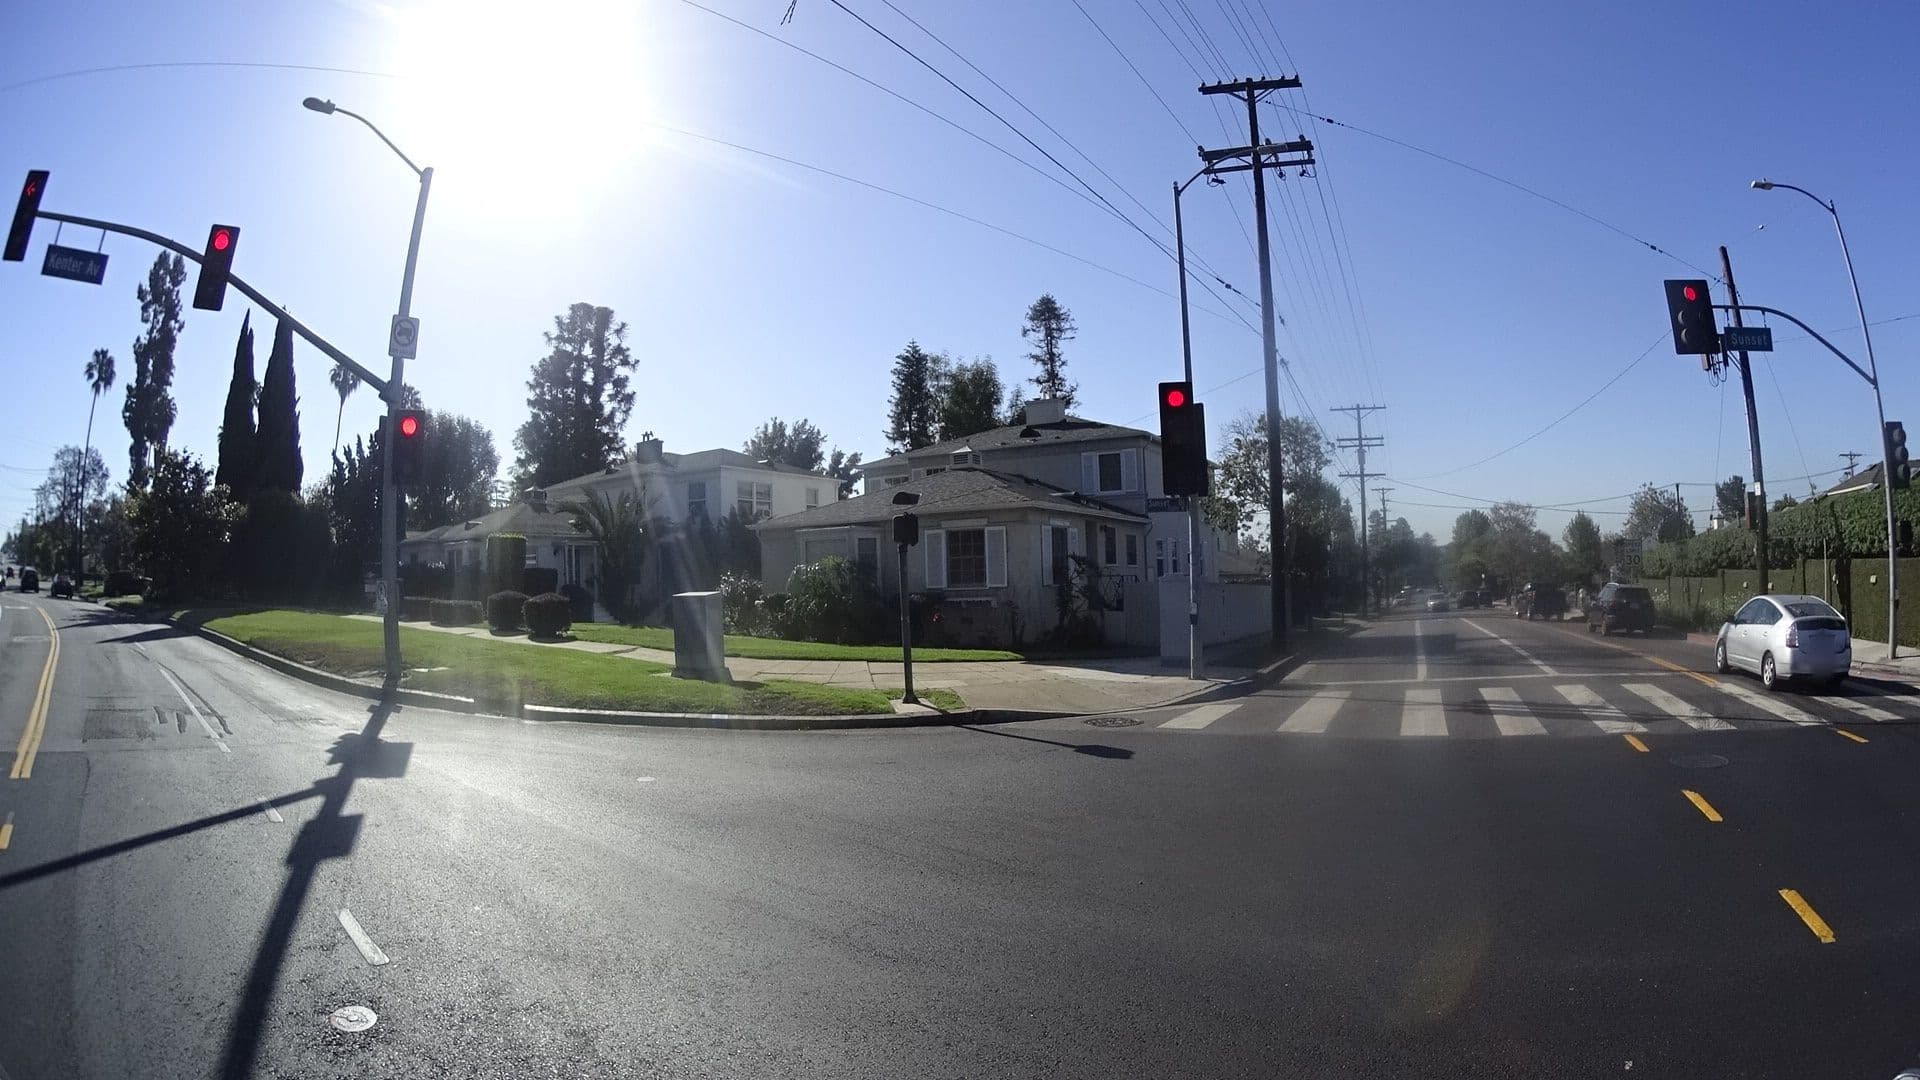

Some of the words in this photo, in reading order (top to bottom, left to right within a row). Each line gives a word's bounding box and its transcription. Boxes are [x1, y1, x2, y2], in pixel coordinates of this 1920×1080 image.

[48, 253, 84, 273] Kenter
[86, 260, 101, 277] Av
[1731, 332, 1768, 346] Sunset
[1625, 554, 1641, 565] 30
